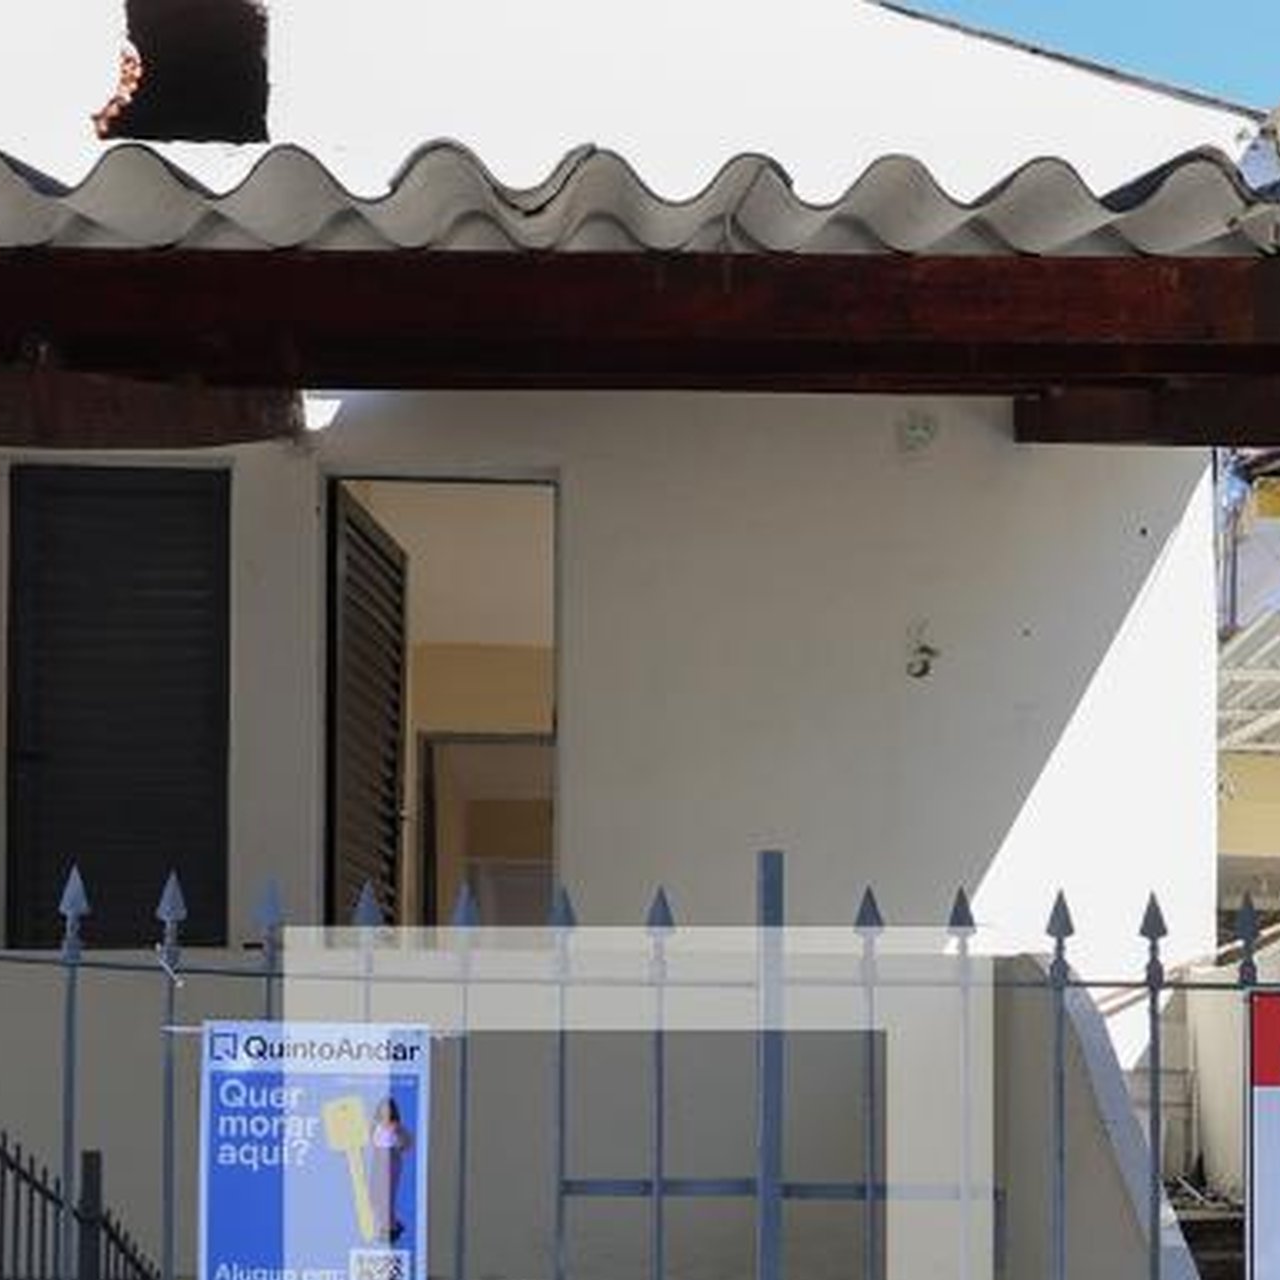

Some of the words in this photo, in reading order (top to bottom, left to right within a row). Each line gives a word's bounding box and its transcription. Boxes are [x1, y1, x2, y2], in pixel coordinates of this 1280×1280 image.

[243, 1035, 421, 1062] QuintoAndar
[220, 1079, 306, 1108] Quer
[219, 1114, 318, 1138] morar
[218, 1140, 310, 1171] aqui?
